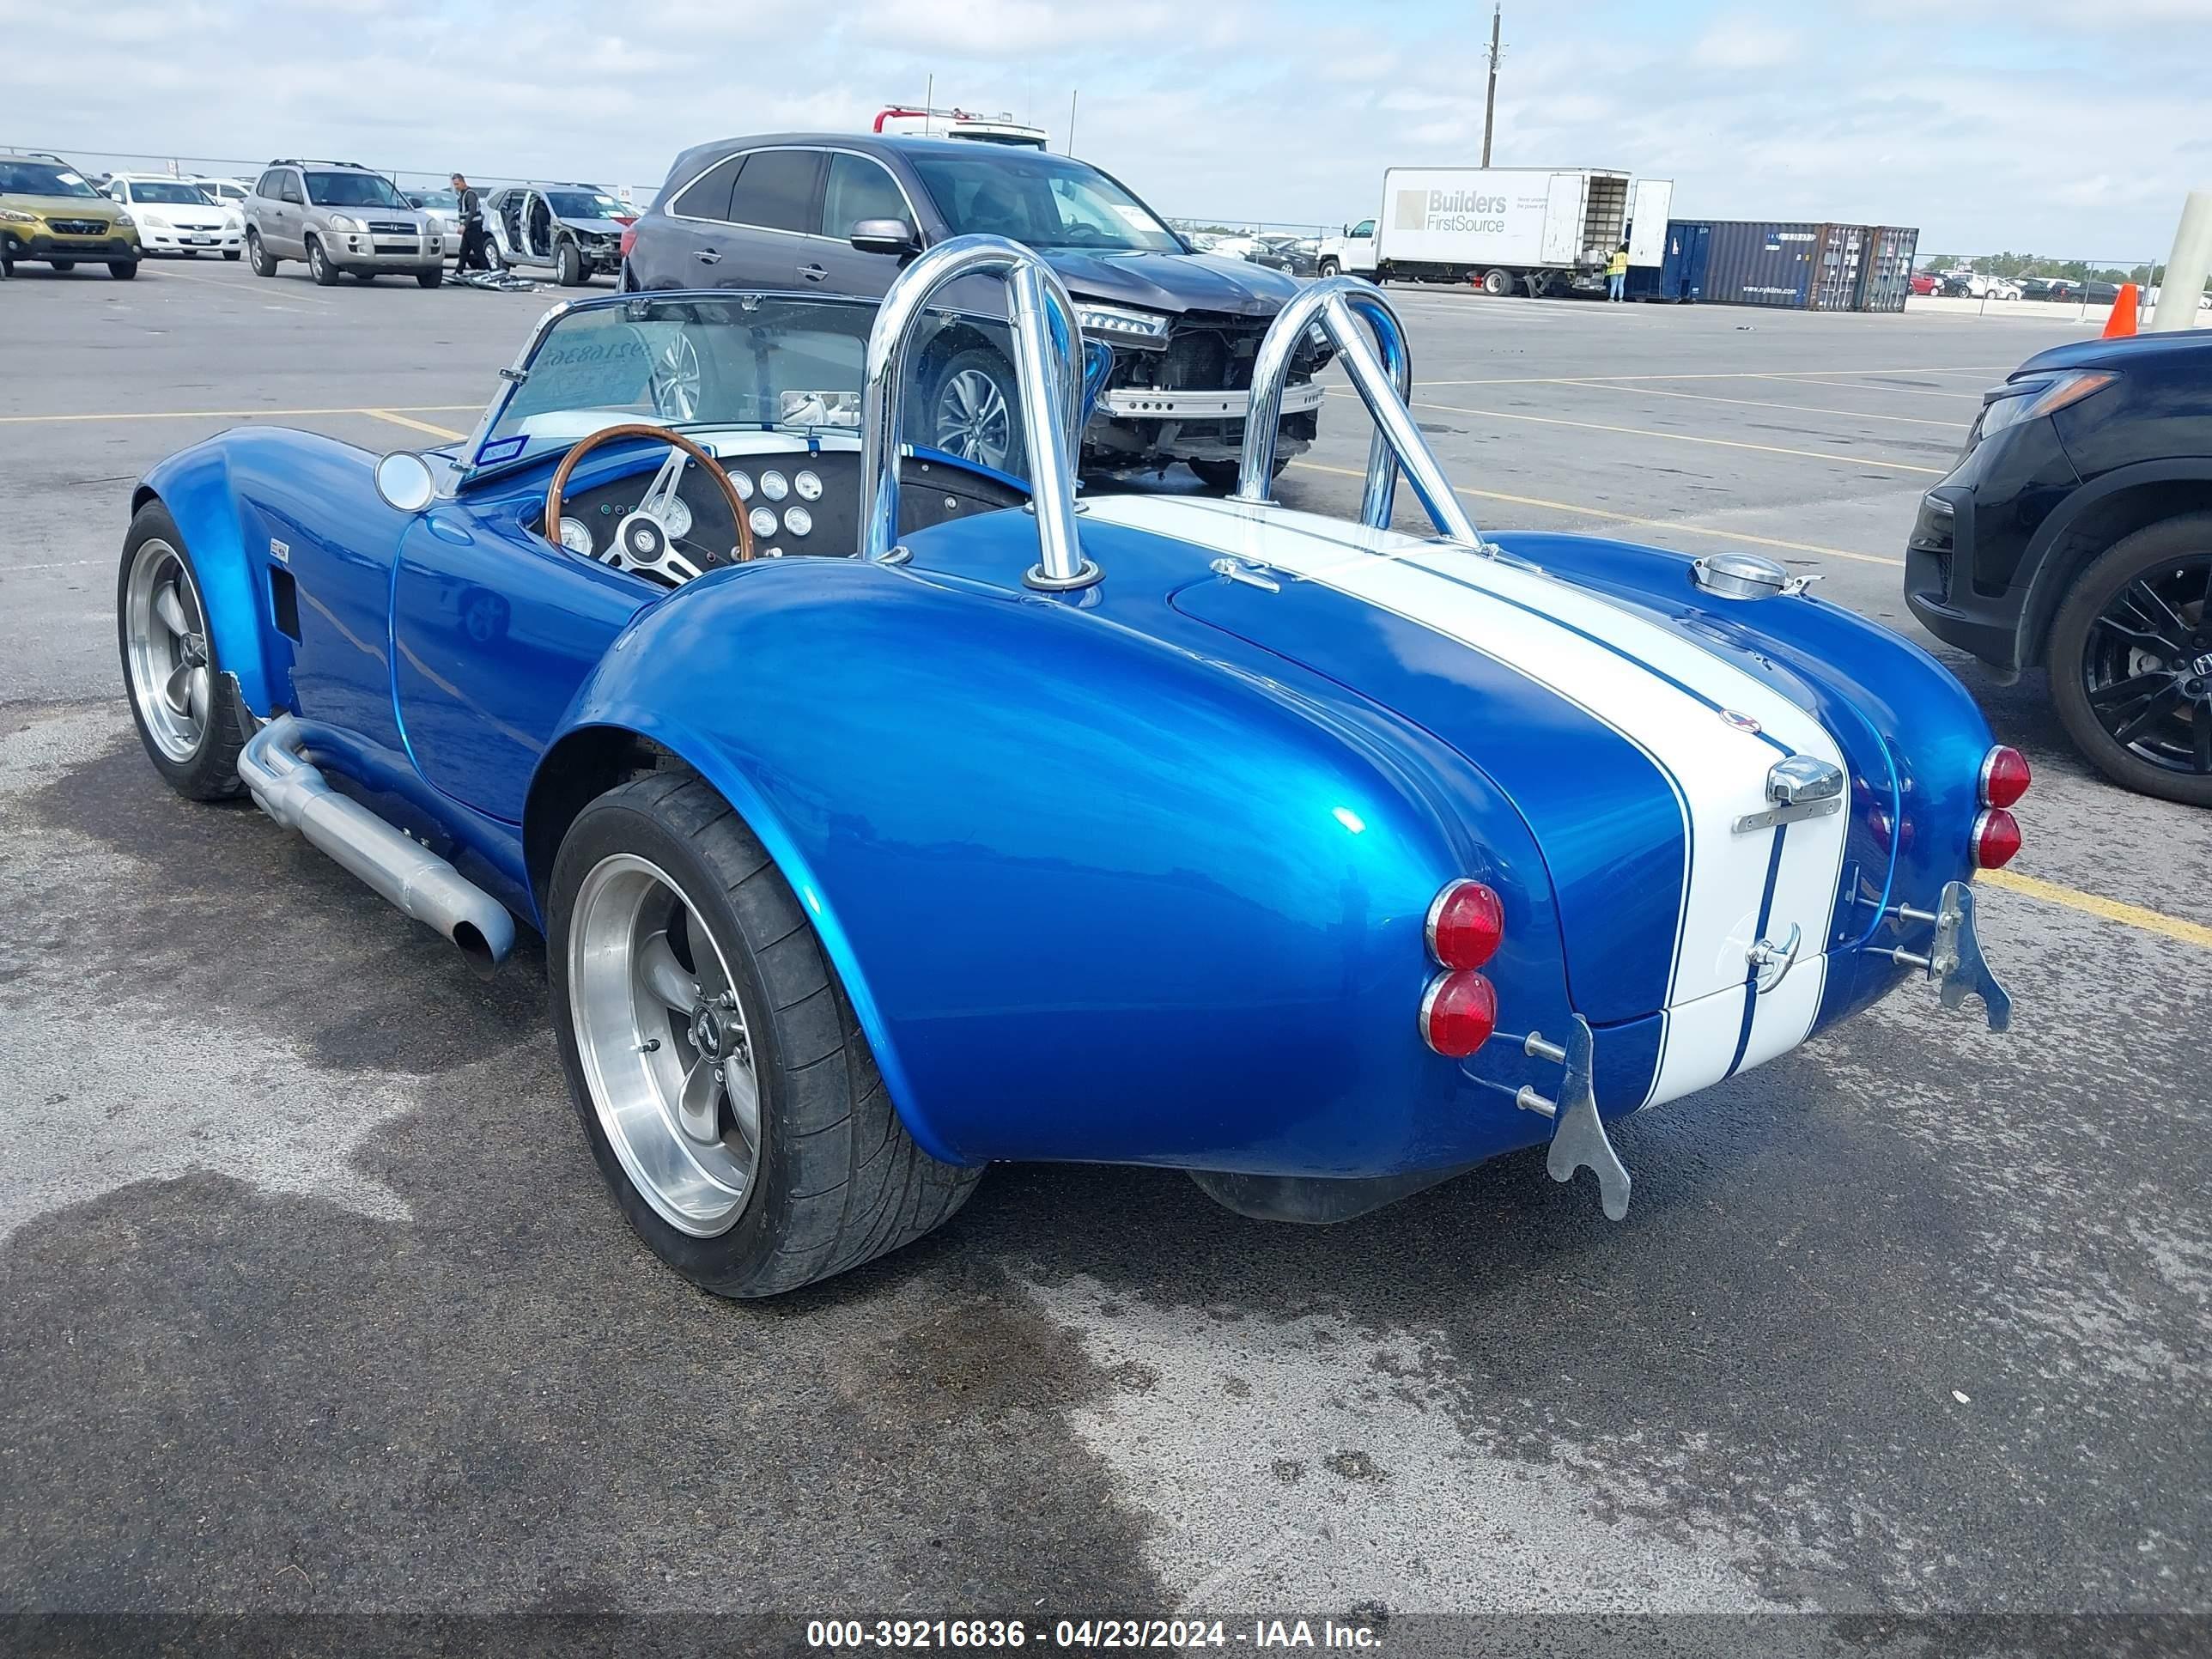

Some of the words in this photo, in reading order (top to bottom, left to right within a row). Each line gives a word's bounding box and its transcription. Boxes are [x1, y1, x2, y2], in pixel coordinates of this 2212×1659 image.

[1429, 190, 1506, 214] Builders
[1427, 215, 1504, 233] FirstSource
[1742, 286, 1798, 295] www.nykline.com
